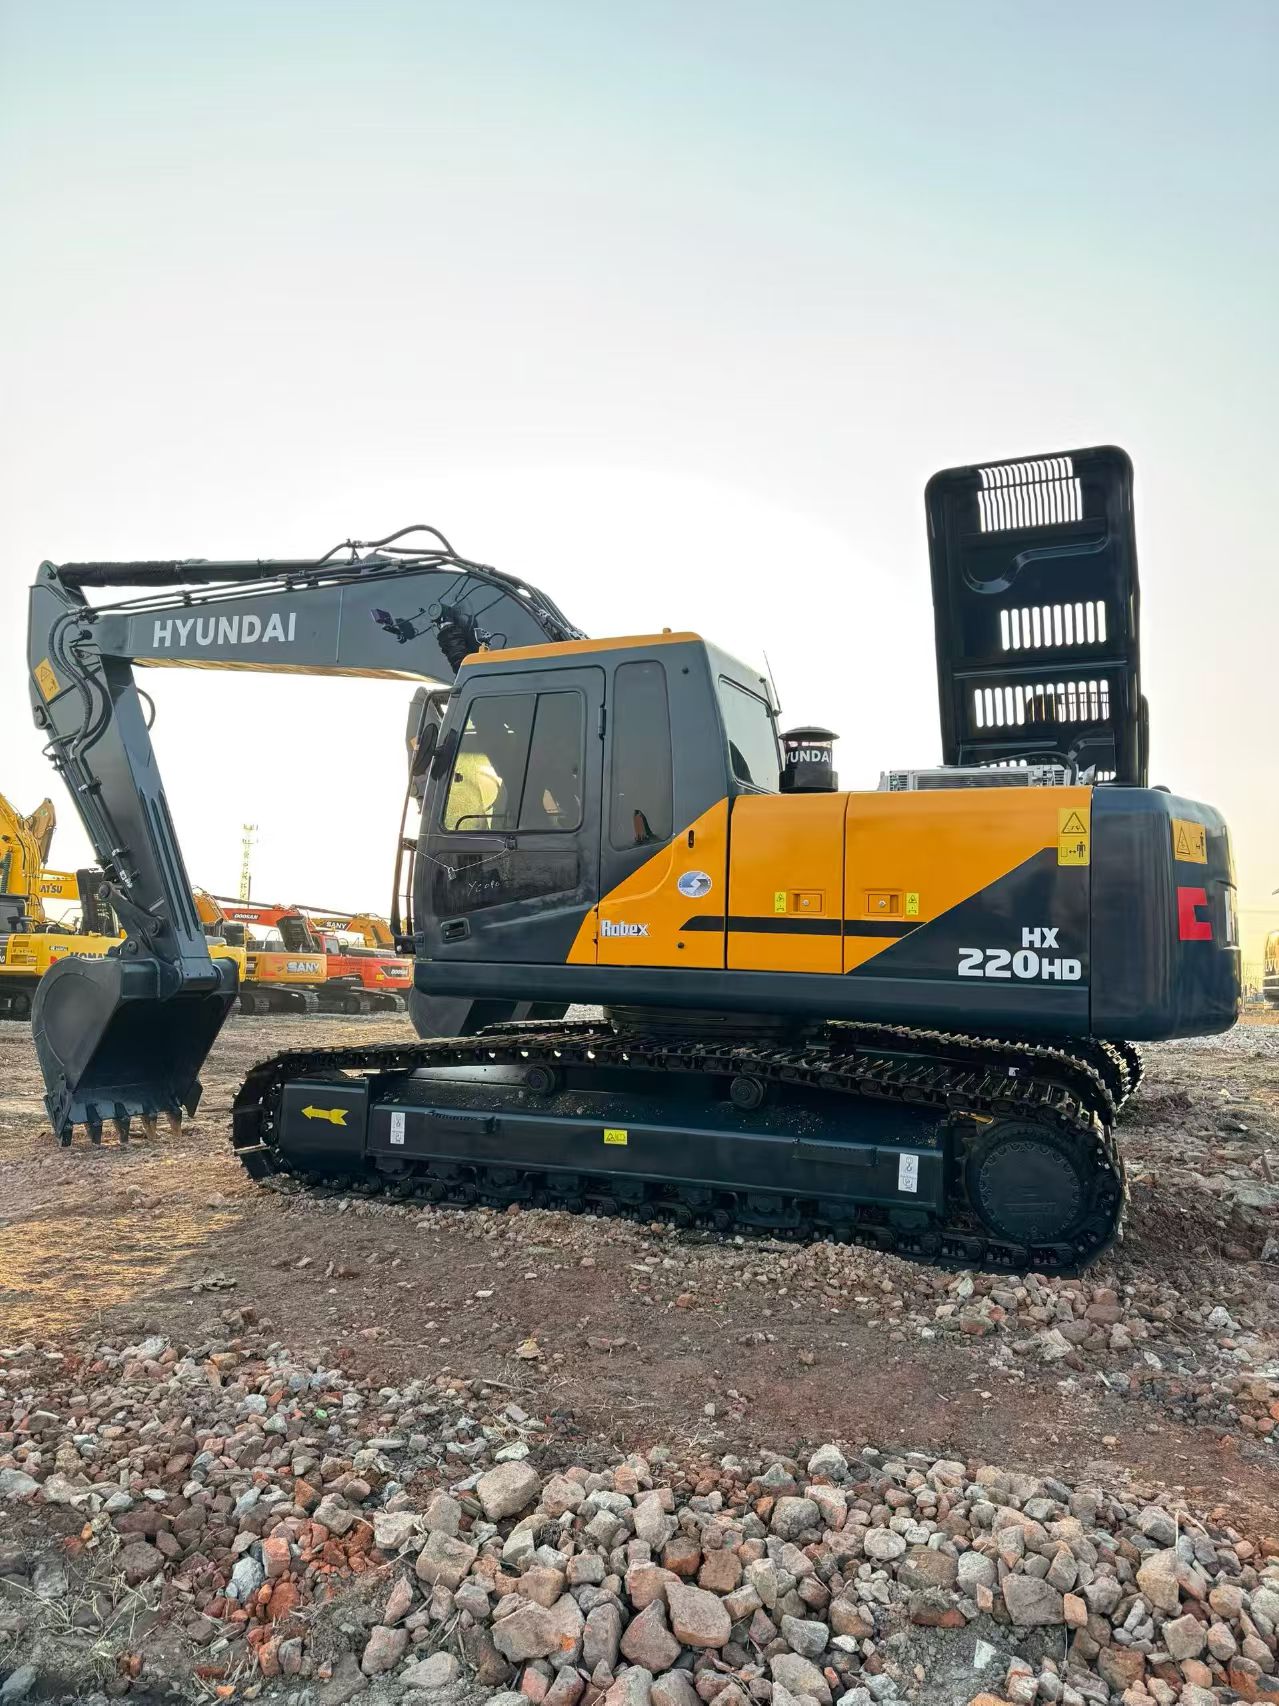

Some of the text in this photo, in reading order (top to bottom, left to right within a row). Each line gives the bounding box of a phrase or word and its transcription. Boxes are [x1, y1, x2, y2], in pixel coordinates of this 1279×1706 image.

[152, 612, 297, 648] HYUNDAI
[785, 750, 832, 764] YUNDAI
[40, 883, 63, 894] ATSU
[326, 921, 347, 929] SANY
[1022, 927, 1060, 948] HX
[287, 961, 320, 974] SANY
